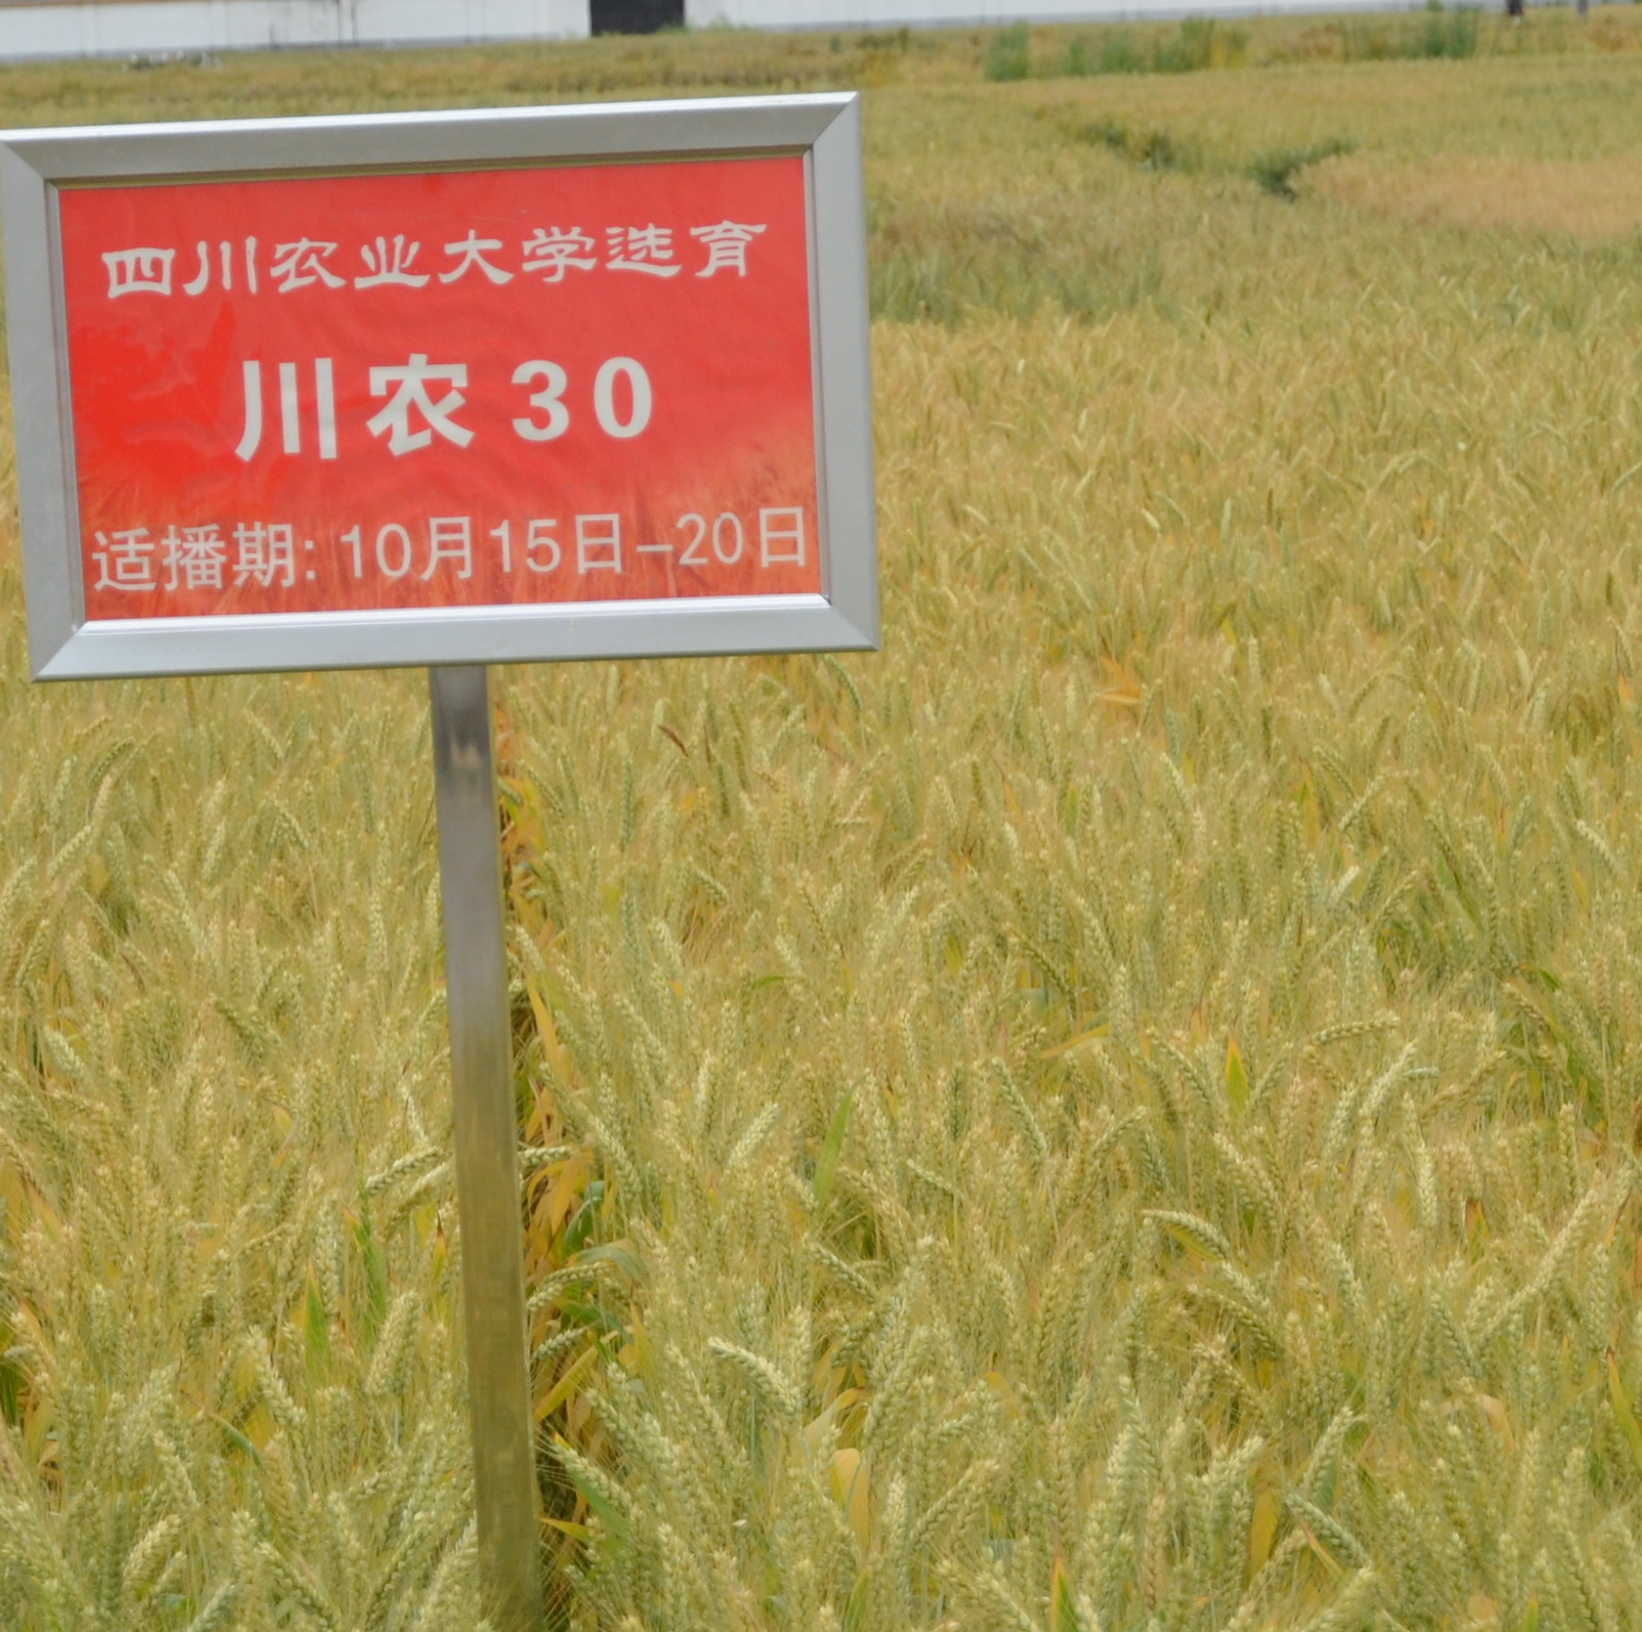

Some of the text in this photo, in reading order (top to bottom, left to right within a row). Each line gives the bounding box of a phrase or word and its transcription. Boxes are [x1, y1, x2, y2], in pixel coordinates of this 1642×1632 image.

[101, 219, 768, 299] 四川农业大学选育
